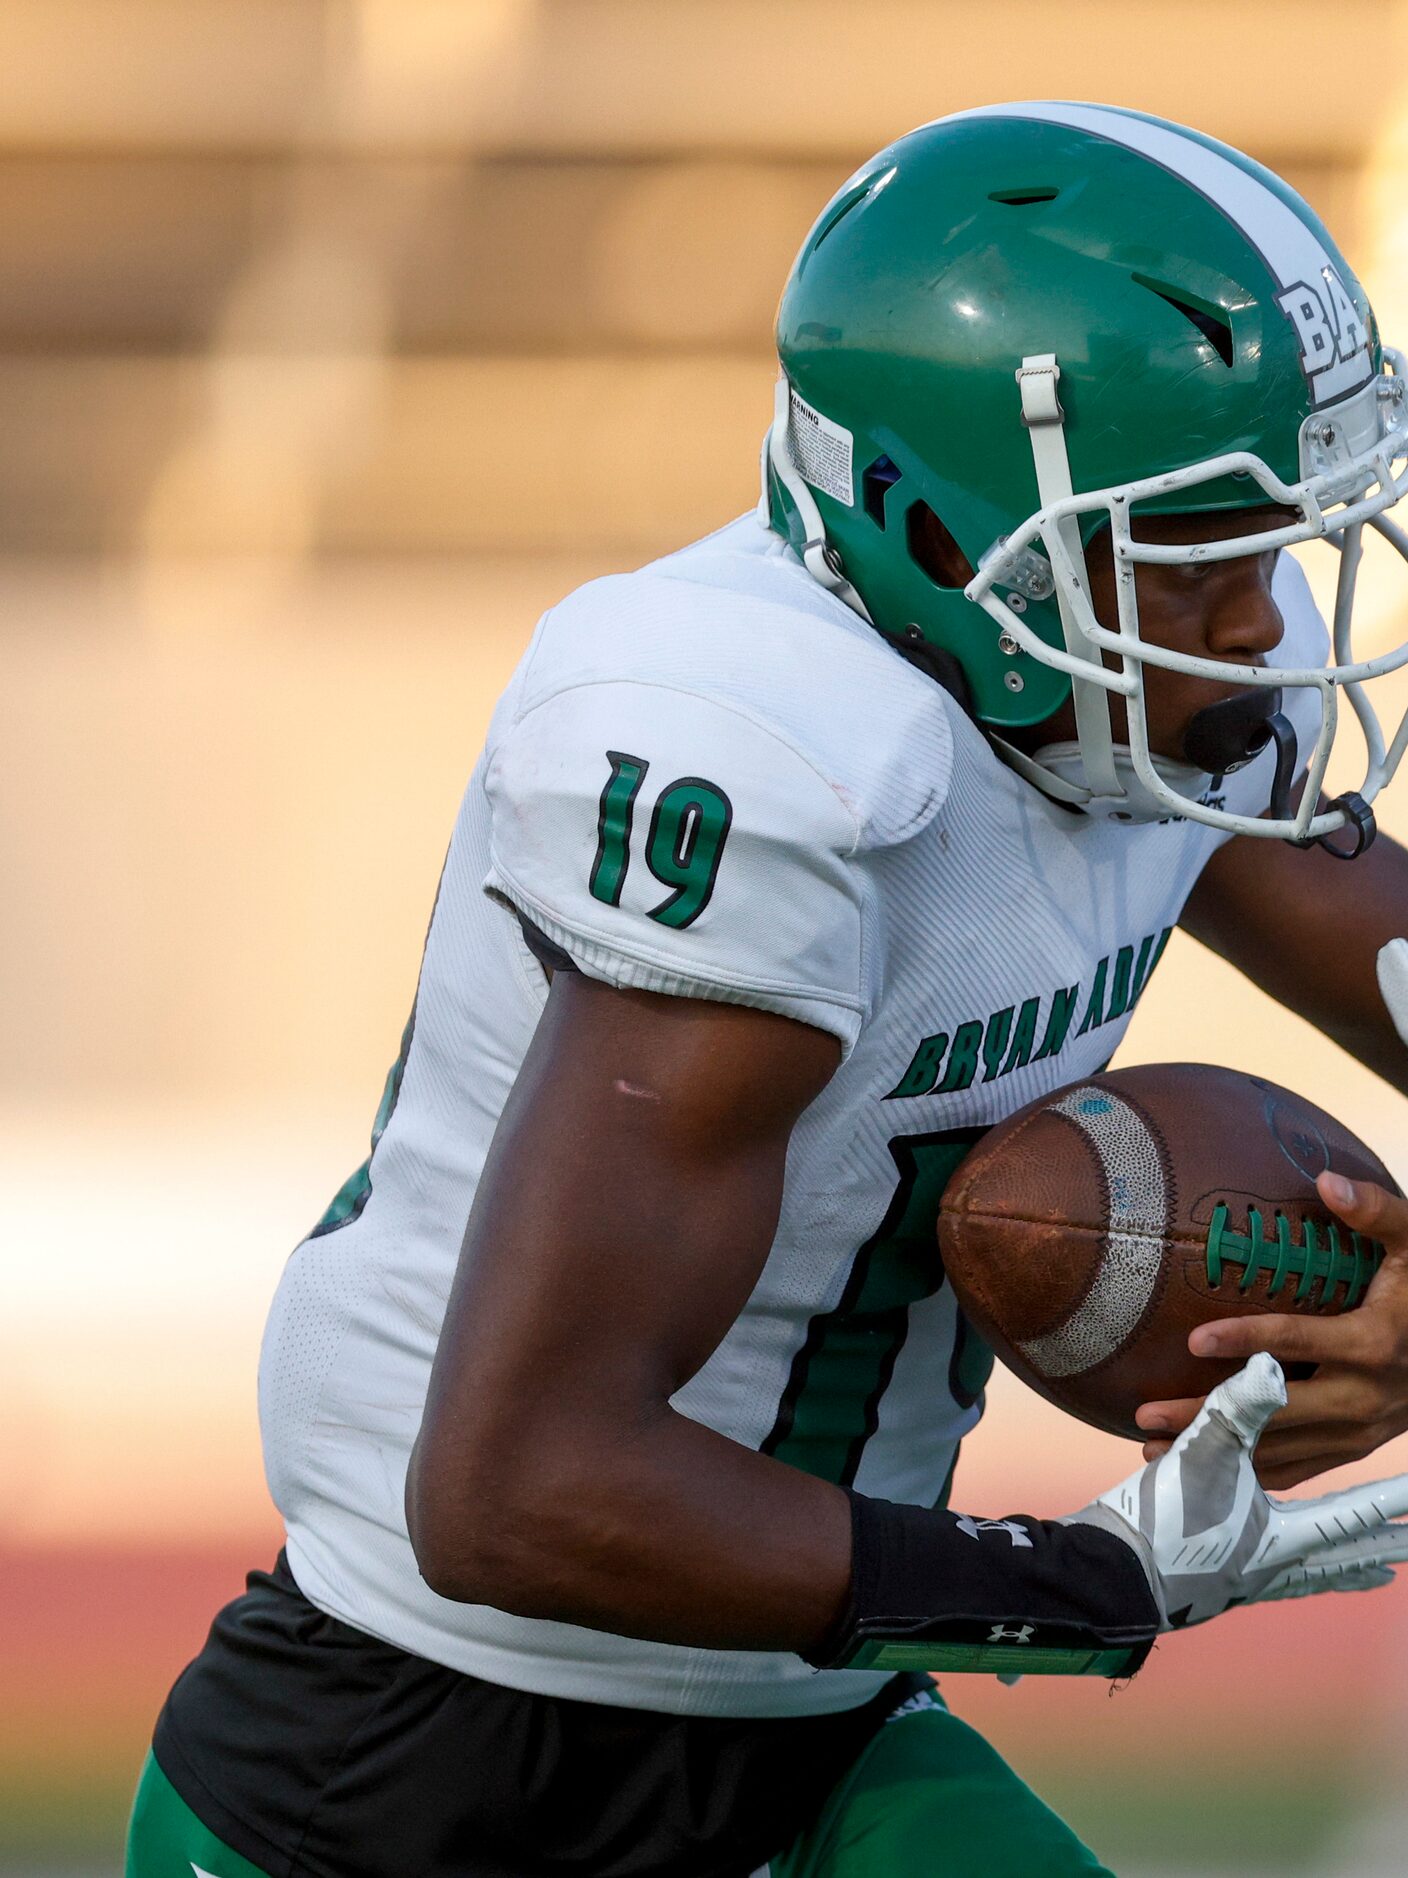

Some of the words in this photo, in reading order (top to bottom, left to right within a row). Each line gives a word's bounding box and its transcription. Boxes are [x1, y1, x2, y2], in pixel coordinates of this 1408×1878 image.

[1273, 263, 1369, 374] BA
[588, 750, 733, 930] 19
[879, 981, 1080, 1102] BRYAN
